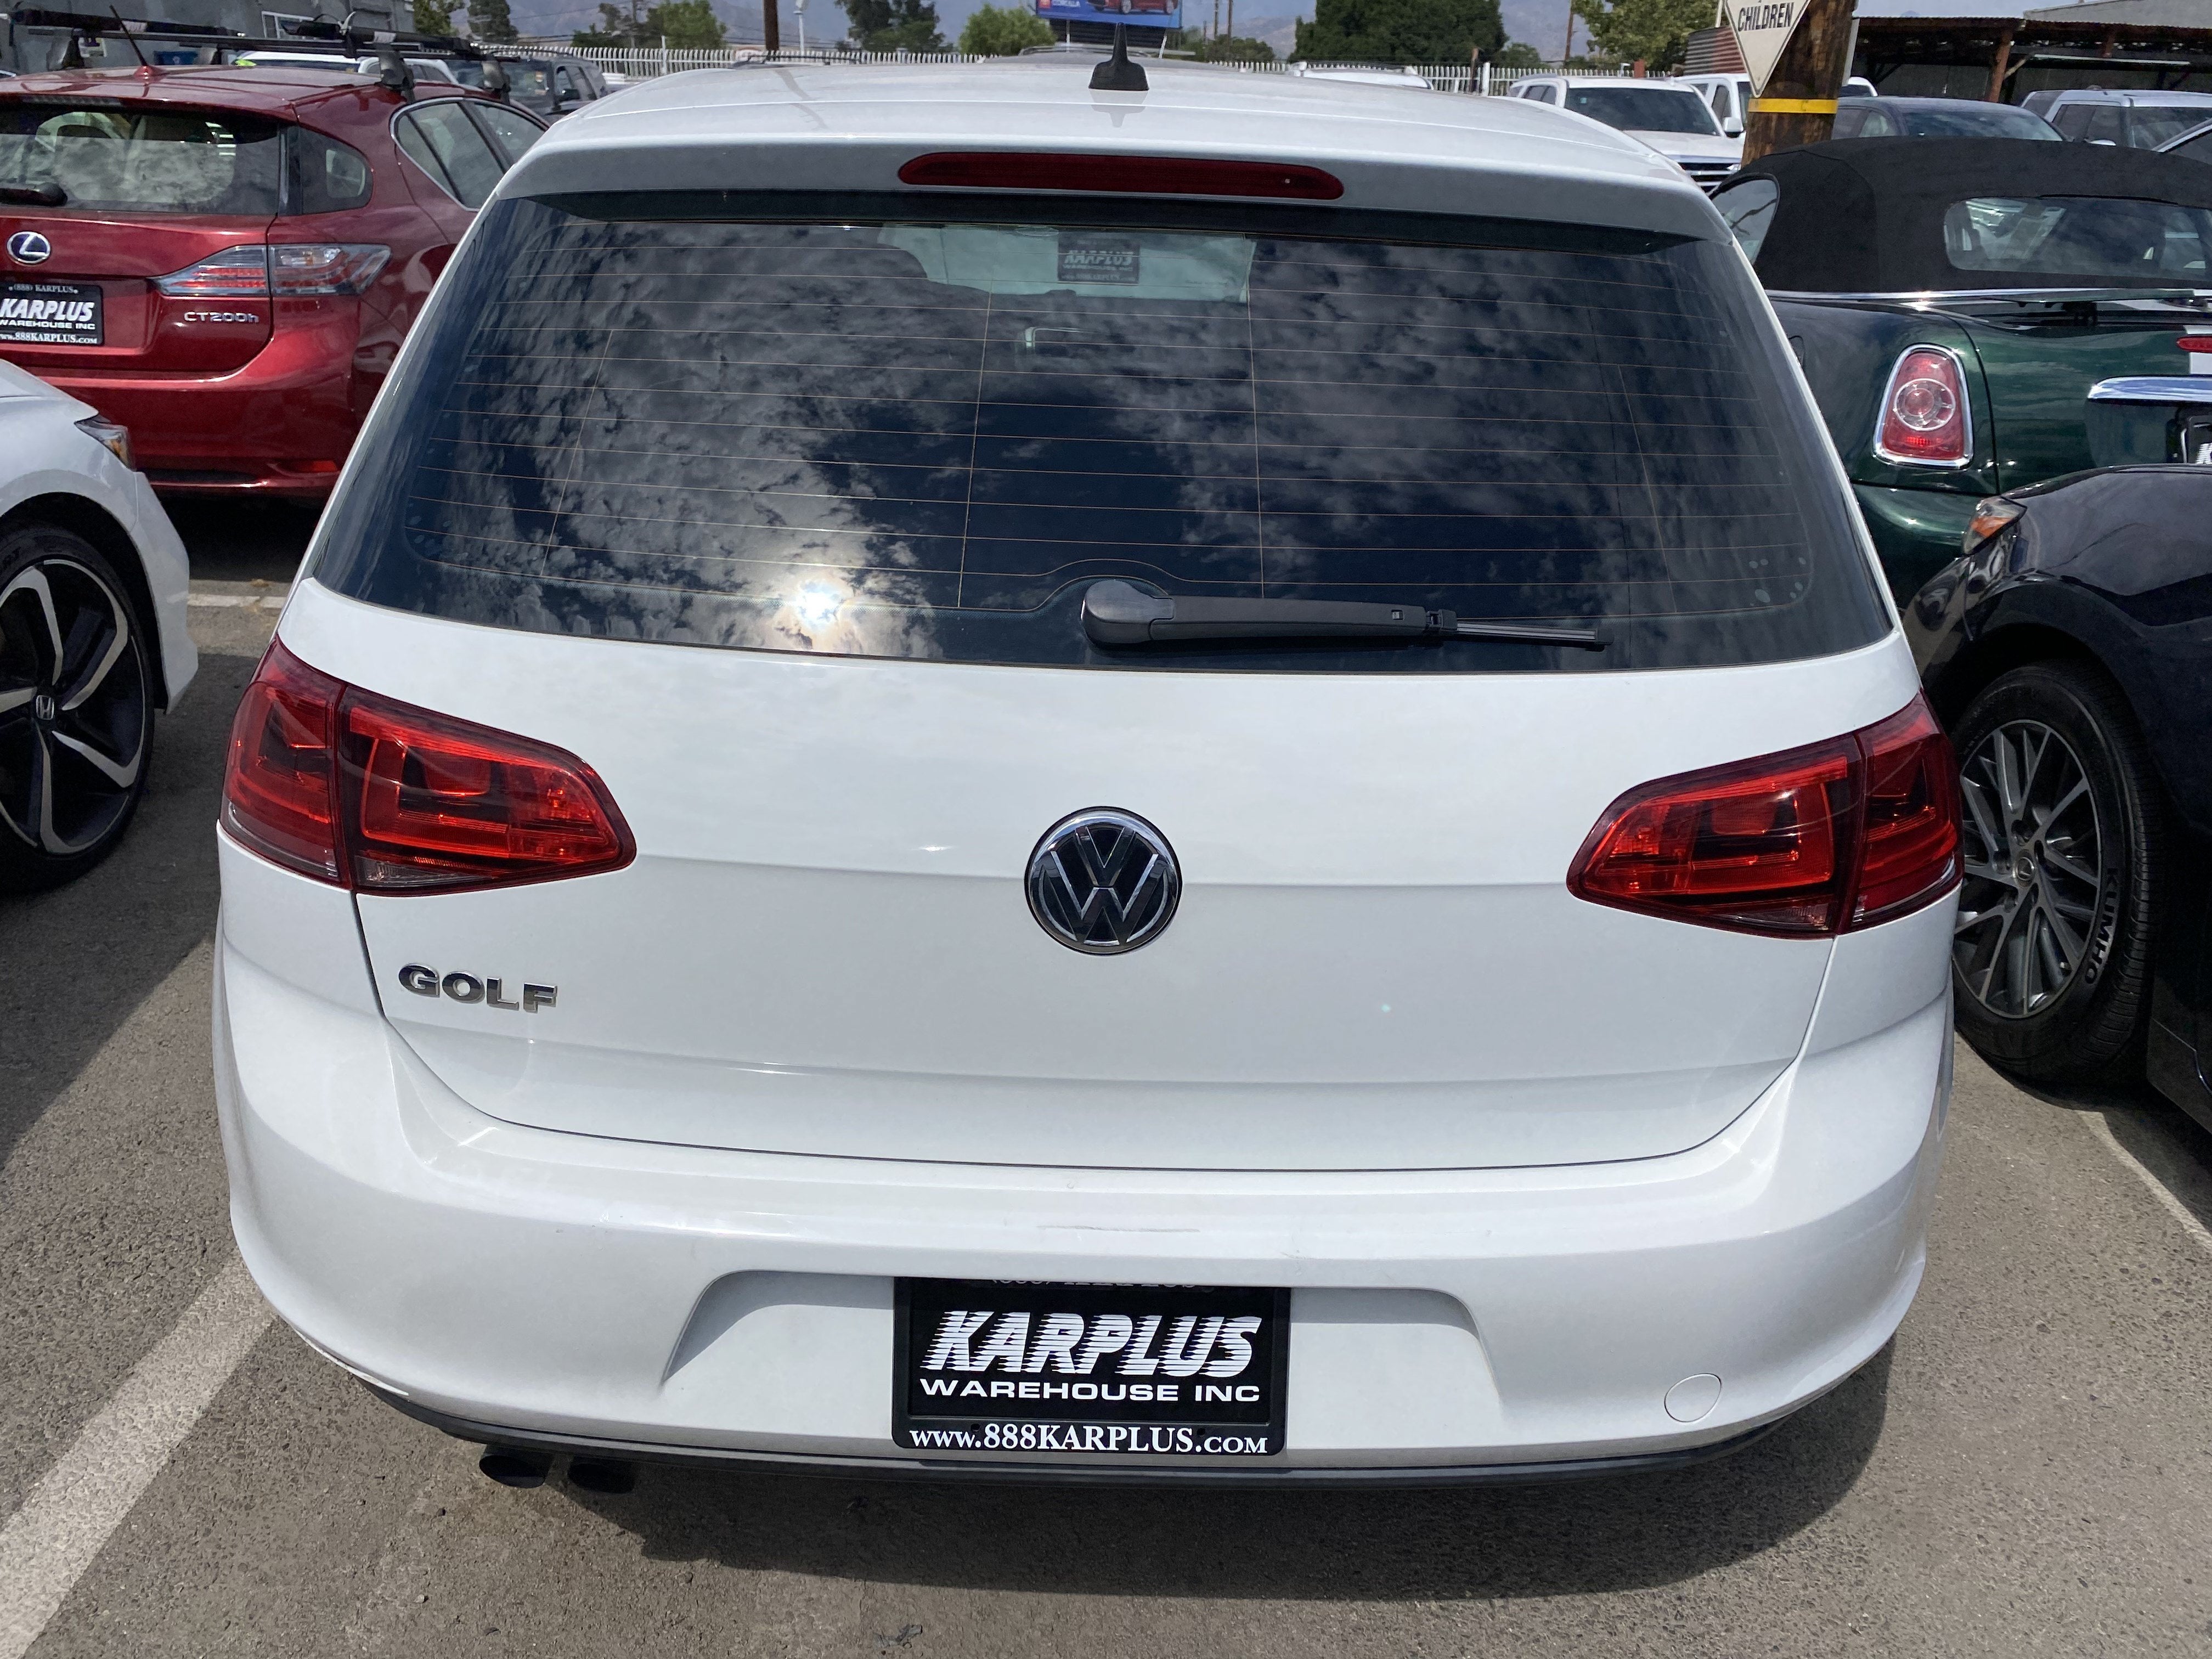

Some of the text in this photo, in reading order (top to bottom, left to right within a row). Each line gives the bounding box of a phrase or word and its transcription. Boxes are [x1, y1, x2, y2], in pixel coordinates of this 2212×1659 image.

[1738, 2, 1795, 31] CHILDREN
[35, 284, 74, 294] KARPLUS
[0, 298, 95, 322] KARPLUS
[0, 319, 72, 329] WAREHOUSE
[2085, 868, 2119, 984] KUMHO
[398, 963, 557, 1013] GOLF
[919, 1310, 1262, 1378] KARPLUS
[919, 1378, 1260, 1402] WAREHOUSE INC
